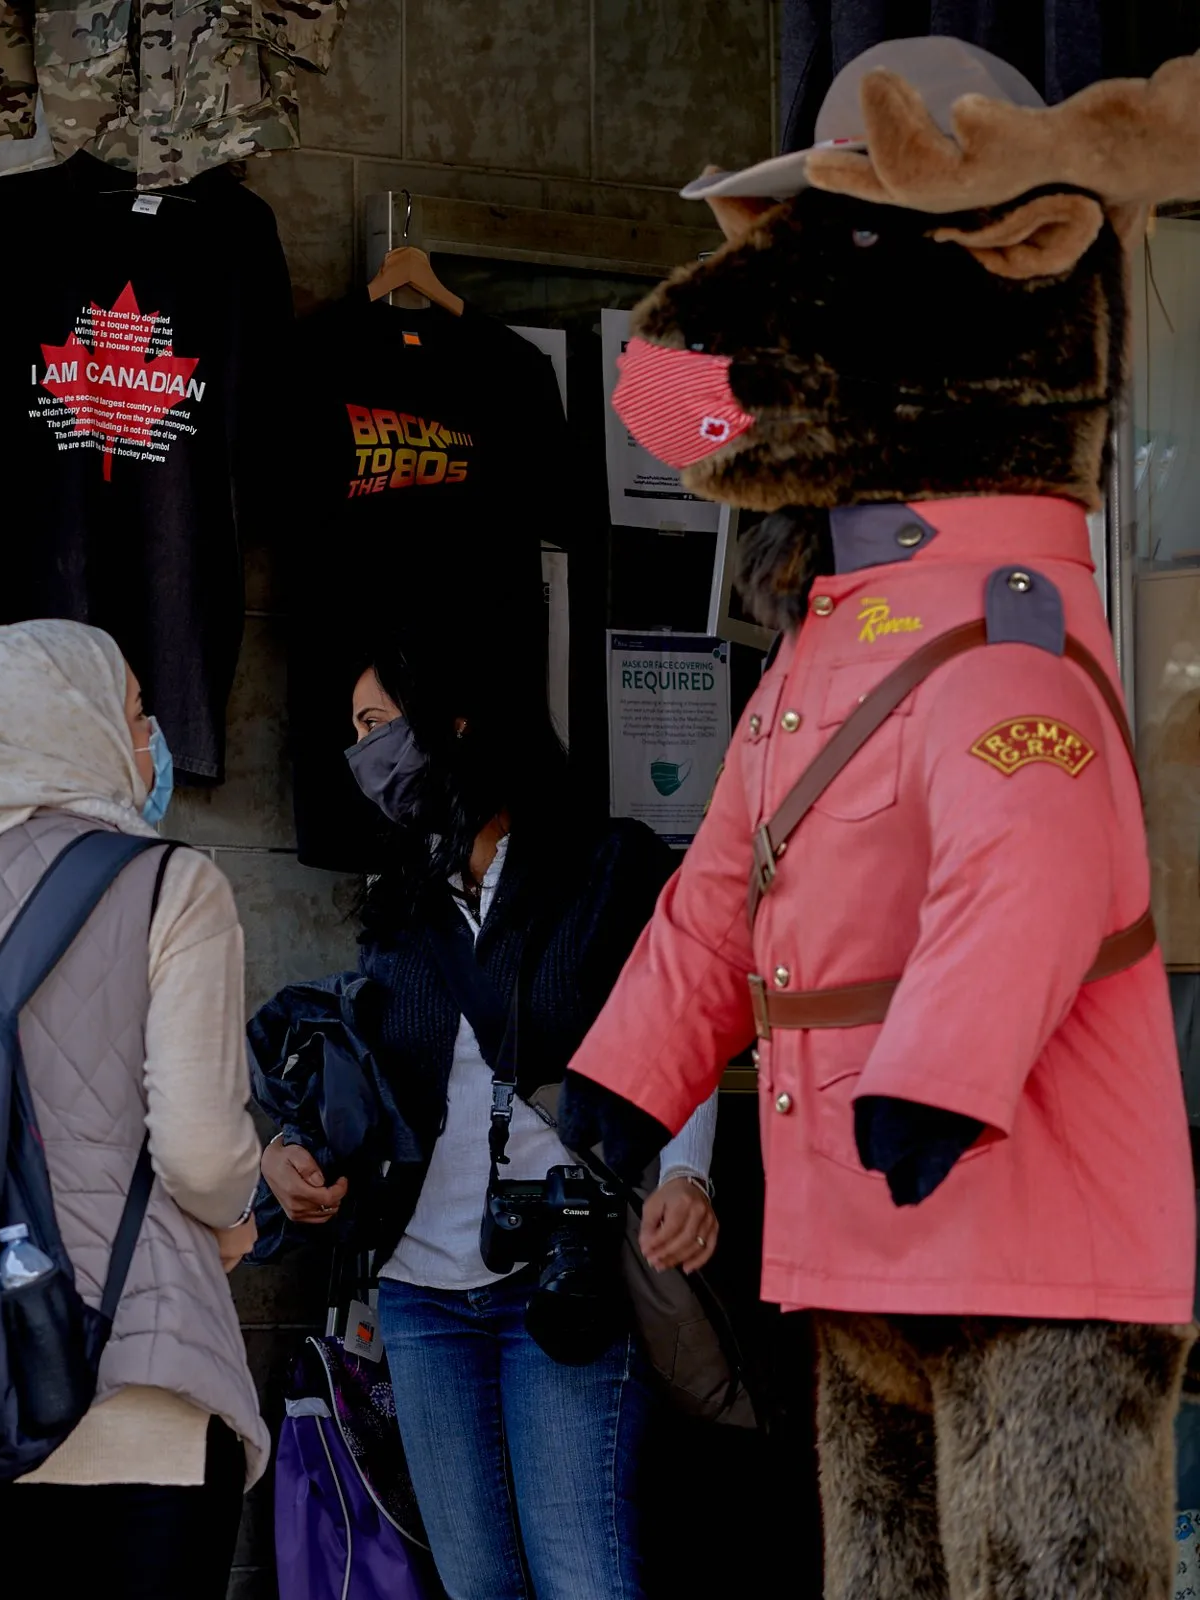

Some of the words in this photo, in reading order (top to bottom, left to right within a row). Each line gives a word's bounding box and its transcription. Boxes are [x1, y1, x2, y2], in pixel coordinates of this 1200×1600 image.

[81, 306, 85, 314] I
[86, 307, 107, 317] don't
[108, 310, 130, 320] travel
[131, 312, 141, 323] by
[142, 314, 170, 325] dogsled
[74, 327, 99, 336] Winter
[100, 330, 108, 338] is
[109, 332, 123, 340] not
[123, 333, 133, 341] all
[134, 335, 151, 343] year
[151, 337, 172, 346] round
[80, 318, 99, 326] wear
[107, 321, 129, 331] toque
[130, 324, 143, 332] not
[150, 325, 161, 334] fur
[162, 327, 173, 336] hat
[76, 337, 90, 345] live
[106, 341, 130, 351] house
[131, 345, 143, 353] not
[155, 347, 173, 357] igloo
[31, 364, 37, 385] I
[42, 361, 78, 384] AM
[85, 362, 206, 402] CANADIAN
[28, 409, 41, 418] We
[42, 408, 63, 416] didn't
[63, 406, 81, 416] copy
[116, 411, 132, 421] from
[133, 414, 144, 423] the
[145, 416, 164, 425] game
[37, 397, 51, 405] We
[64, 394, 75, 403] the
[99, 396, 126, 408] largest
[126, 402, 152, 413] country
[153, 404, 161, 412] in
[170, 408, 190, 419] world
[46, 420, 61, 428] The
[96, 420, 122, 433] building
[123, 424, 129, 432] is
[129, 426, 141, 434] not
[142, 428, 161, 439] made
[168, 432, 177, 441] ice
[346, 403, 448, 449] BACK
[54, 431, 67, 440] The
[67, 429, 89, 438] maple
[120, 437, 145, 447] national
[147, 440, 170, 452] symbol
[57, 443, 68, 451] We
[68, 441, 79, 449] are
[80, 440, 95, 448] still
[101, 445, 116, 455] best
[117, 448, 141, 460] hockey
[141, 452, 166, 463] players
[356, 448, 393, 476] TO
[348, 475, 389, 498] THE
[622, 660, 641, 668] MASK
[642, 661, 653, 669] OR
[655, 660, 673, 669] FACE
[674, 661, 714, 670] COVERING
[622, 670, 715, 694] REQUIRED
[563, 1208, 590, 1216] Canon
